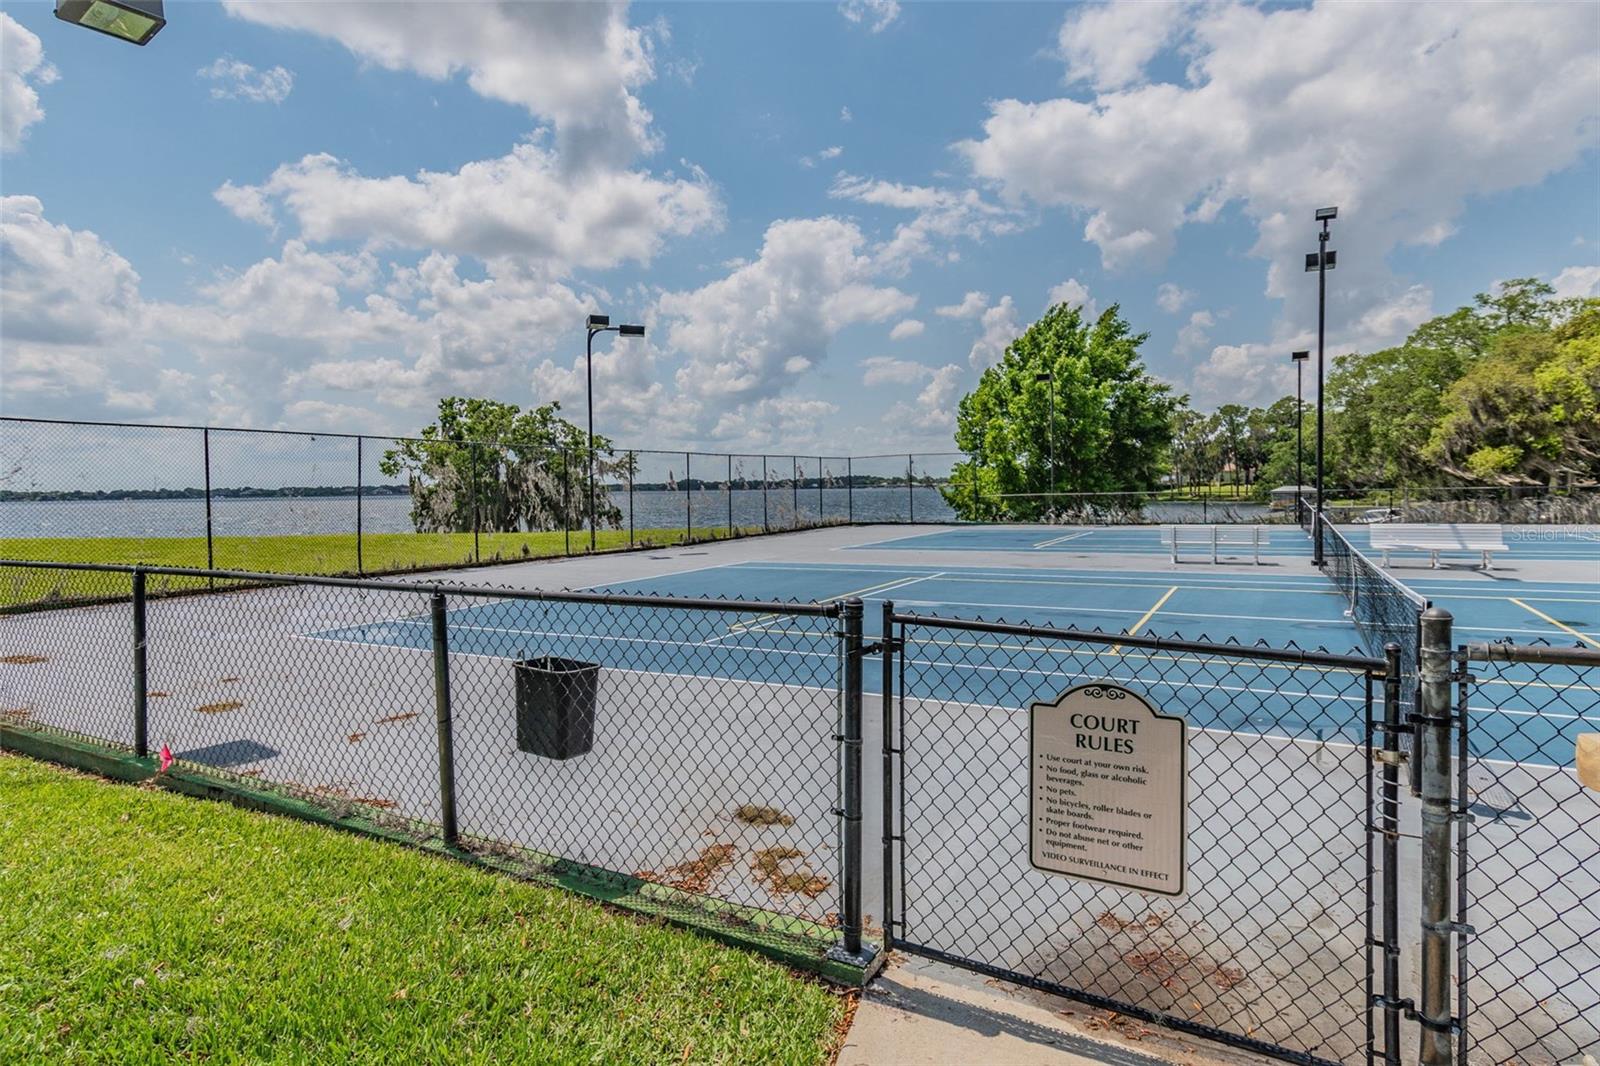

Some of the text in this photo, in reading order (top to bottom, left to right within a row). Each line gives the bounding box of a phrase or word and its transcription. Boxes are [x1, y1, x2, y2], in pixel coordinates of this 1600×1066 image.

[1070, 713, 1140, 735] COURT
[1076, 734, 1134, 755] RULES
[1047, 754, 1060, 762] Use
[1063, 756, 1082, 764] court
[1094, 761, 1111, 770] your
[1113, 763, 1130, 771] own
[1132, 766, 1149, 774] risk.
[1046, 765, 1057, 773] No
[1060, 766, 1079, 776] food,
[1081, 770, 1098, 779] glass
[1111, 773, 1147, 785] alcoholic
[1046, 775, 1084, 786] beverages.
[1060, 788, 1077, 797] pets.
[1046, 807, 1094, 820] skate boards.
[1059, 798, 1091, 810] bicycles,
[1093, 805, 1114, 813] roller
[1116, 807, 1141, 818] blades
[1046, 817, 1144, 840] Proper footwear required.
[1046, 828, 1057, 836] Do
[1073, 833, 1094, 842] abuse
[1097, 837, 1109, 845] net
[1122, 841, 1143, 851] other
[1046, 839, 1087, 851] equipment.
[1042, 851, 1067, 861] VIDEO
[1069, 856, 1126, 873] SURVEILLANCE
[1141, 869, 1169, 881] EFFECT
